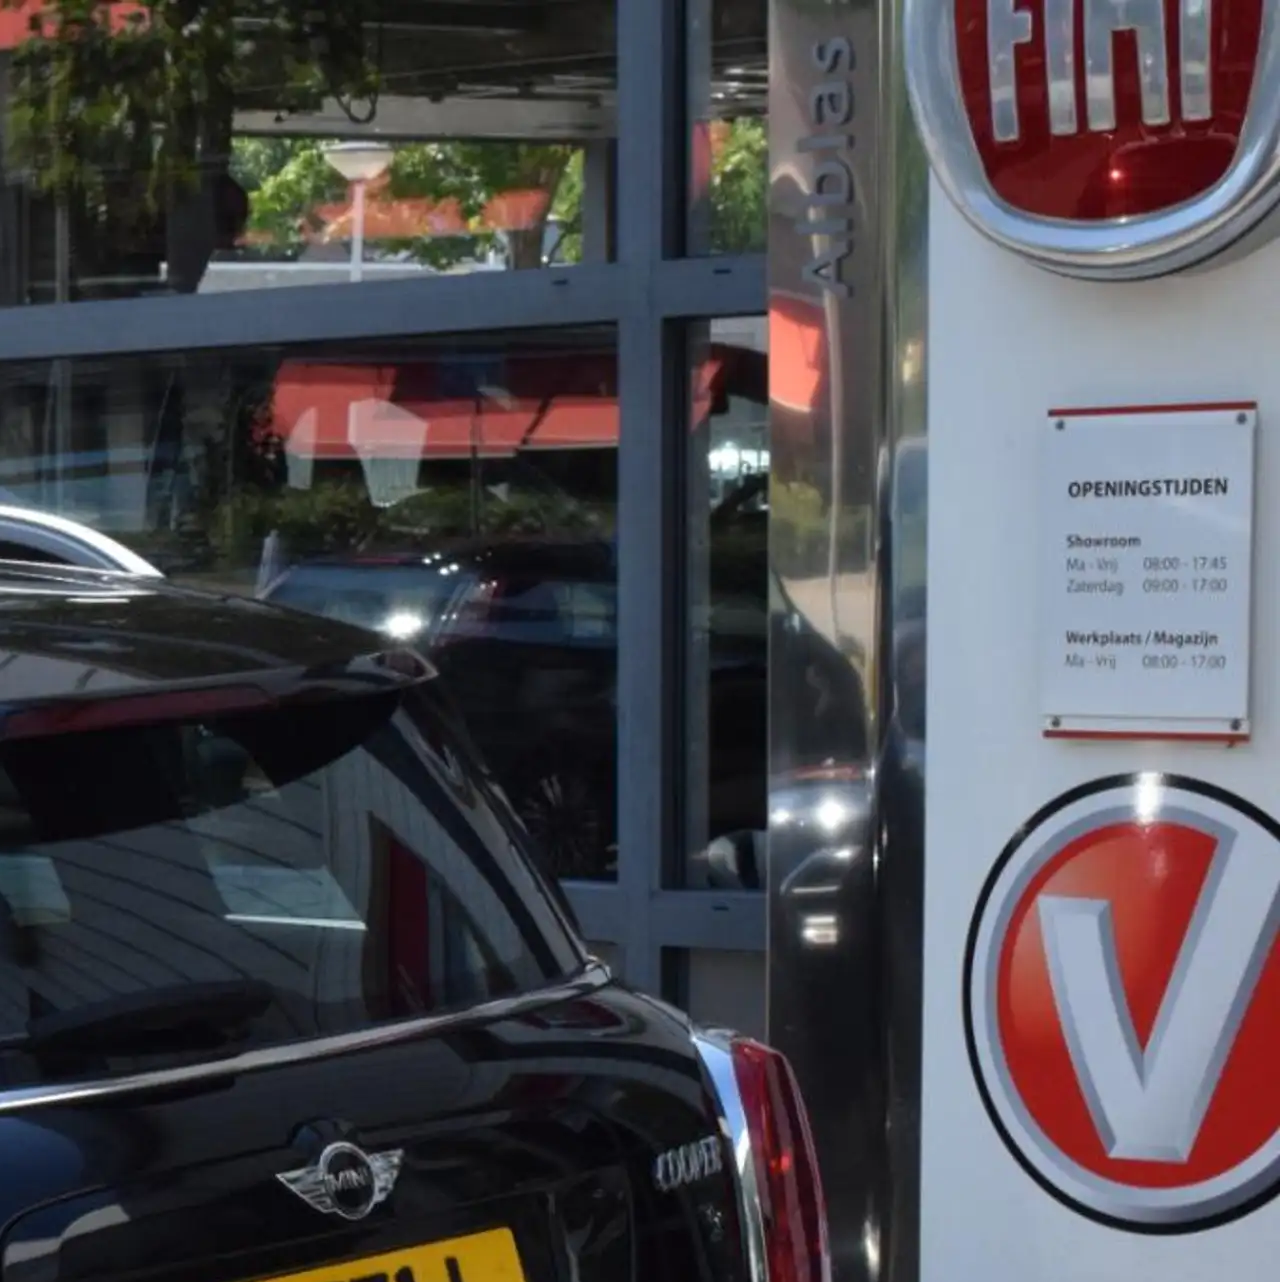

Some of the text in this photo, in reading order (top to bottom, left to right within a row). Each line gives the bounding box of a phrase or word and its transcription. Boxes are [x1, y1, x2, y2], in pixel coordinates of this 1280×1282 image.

[796, 36, 856, 298] Alblas
[1068, 478, 1228, 498] OPENINGSTIJDEN
[1066, 535, 1141, 549] Showroom
[1066, 558, 1086, 571] Ma
[1066, 579, 1124, 596] Zaterdag
[1066, 631, 1141, 646] Werkplaats
[1154, 631, 1218, 648] Magazijn
